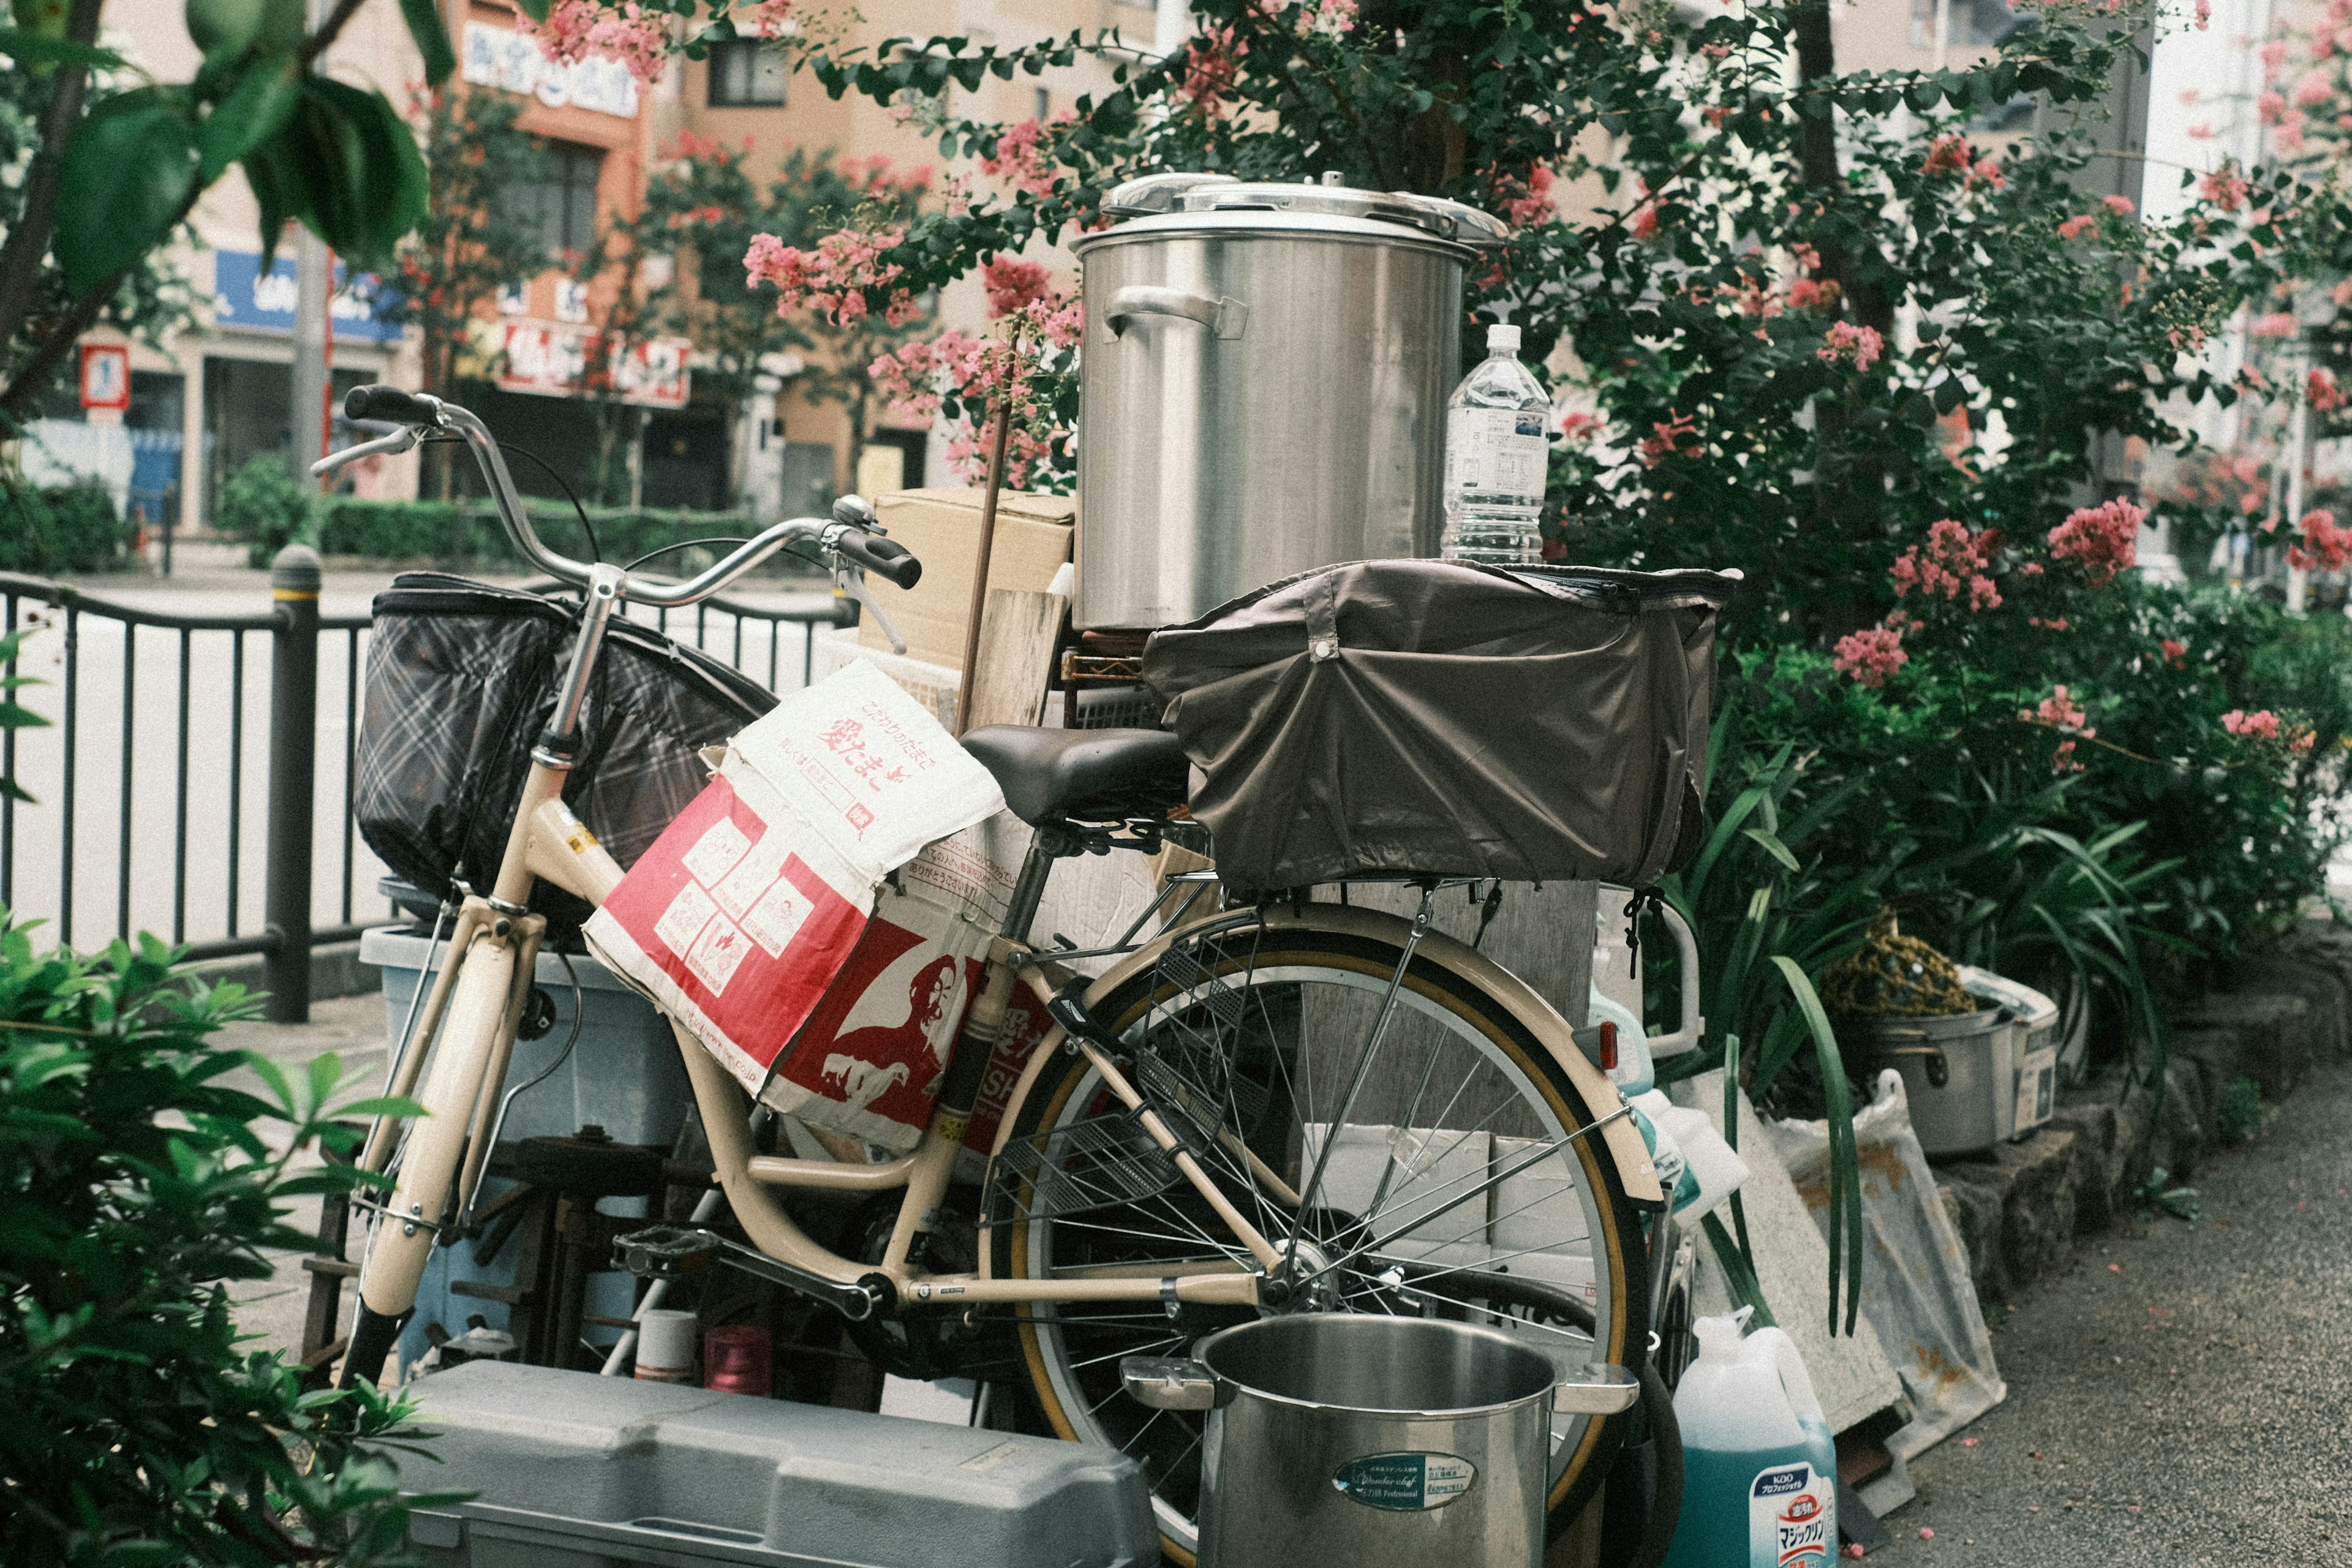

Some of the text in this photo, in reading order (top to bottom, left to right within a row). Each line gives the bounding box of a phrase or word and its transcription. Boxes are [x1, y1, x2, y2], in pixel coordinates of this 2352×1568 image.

[848, 809, 870, 825] 検索
[1362, 1473, 1395, 1485] Wonder
[1762, 1480, 1803, 1494] プロフェッショナル
[1780, 1520, 1823, 1549] マジックリン
